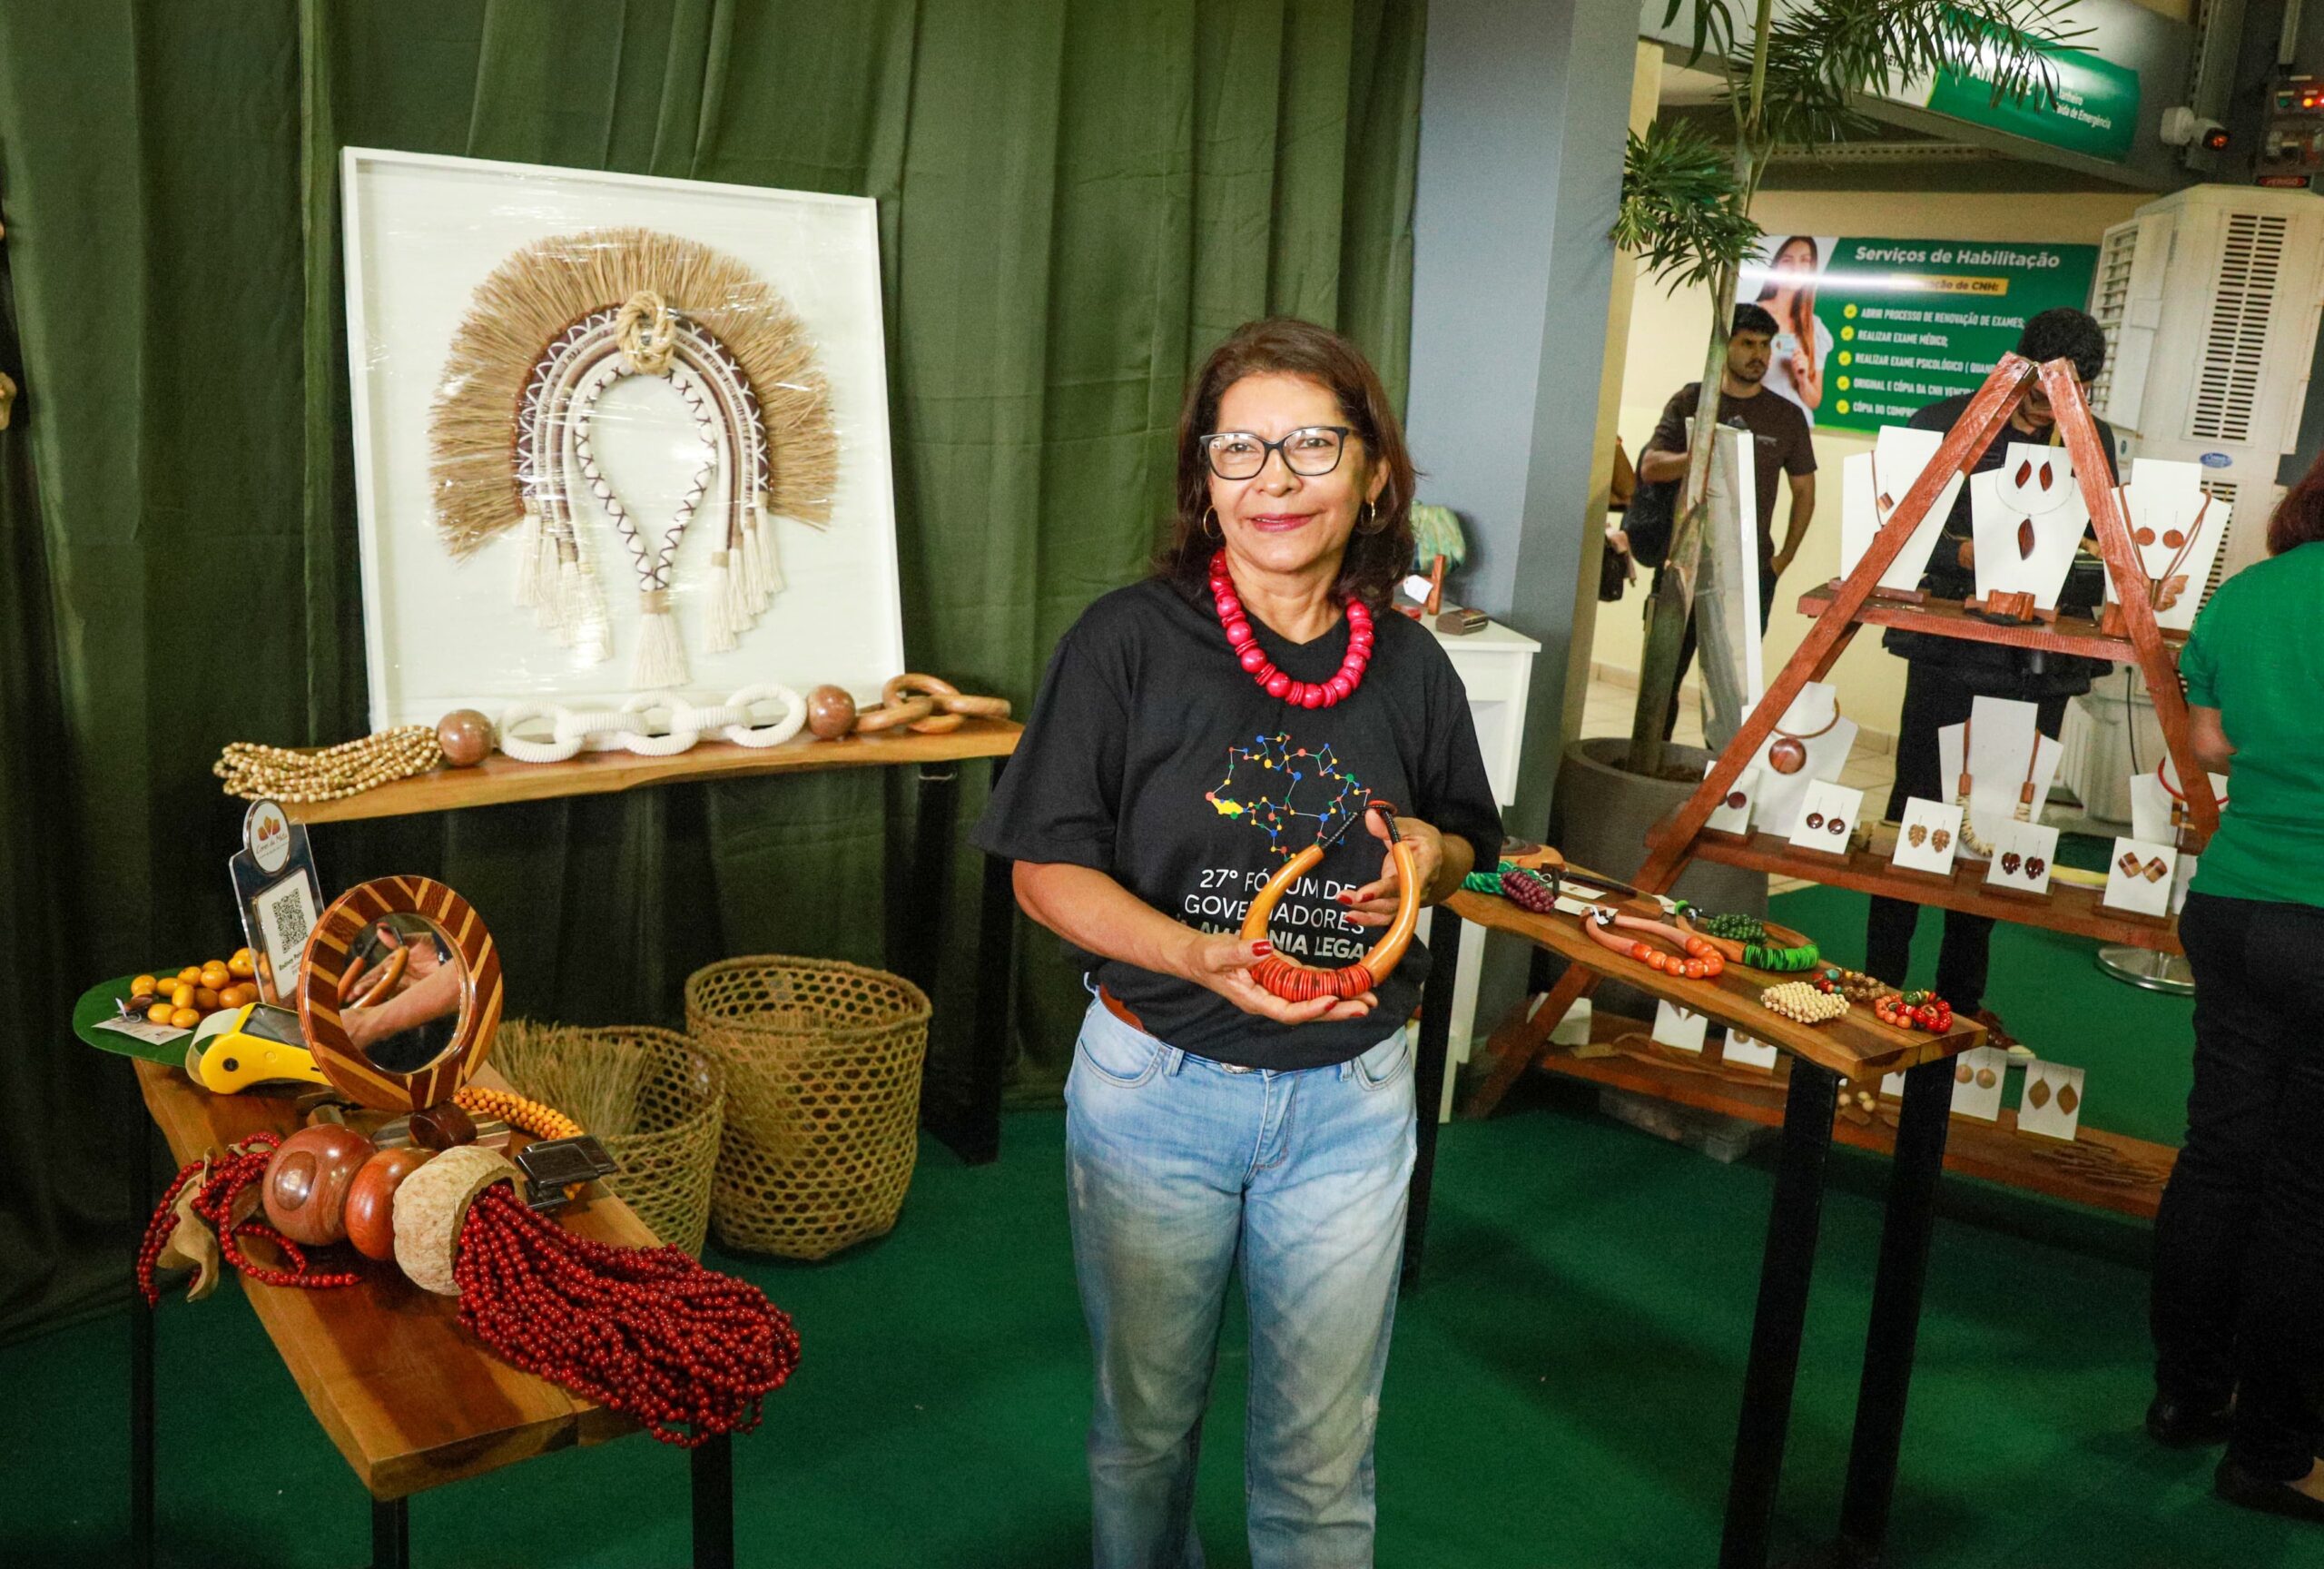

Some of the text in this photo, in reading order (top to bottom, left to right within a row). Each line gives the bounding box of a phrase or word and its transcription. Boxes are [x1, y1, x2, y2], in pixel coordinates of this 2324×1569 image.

[1856, 246, 2060, 270] Serviços de Habilitação
[1956, 281, 1969, 291] de
[1861, 308, 1884, 319] ABRIR
[1884, 309, 1922, 322] PROCESSO
[1923, 311, 1934, 322] DE
[1935, 311, 1979, 327] RENOVAÇÃO
[1980, 315, 1991, 326] DE
[1857, 330, 1893, 342] REALIZAR
[1893, 332, 1917, 344] EXAME
[1855, 352, 1889, 365] REALIZAR
[1890, 355, 1915, 368] EXAME
[1915, 358, 1964, 372] PSICOLÓGICO
[1853, 377, 1886, 391] ORIGINAL
[1886, 380, 1893, 391] E
[1893, 379, 1915, 393] CÓPIA
[1915, 383, 1926, 395] DA
[1853, 400, 1874, 414] CÓPIA
[1875, 402, 1886, 415] DO
[1245, 868, 1319, 899] FÓUM
[1185, 893, 1364, 934] GOVEADORES
[1314, 936, 1374, 960] LEGA
